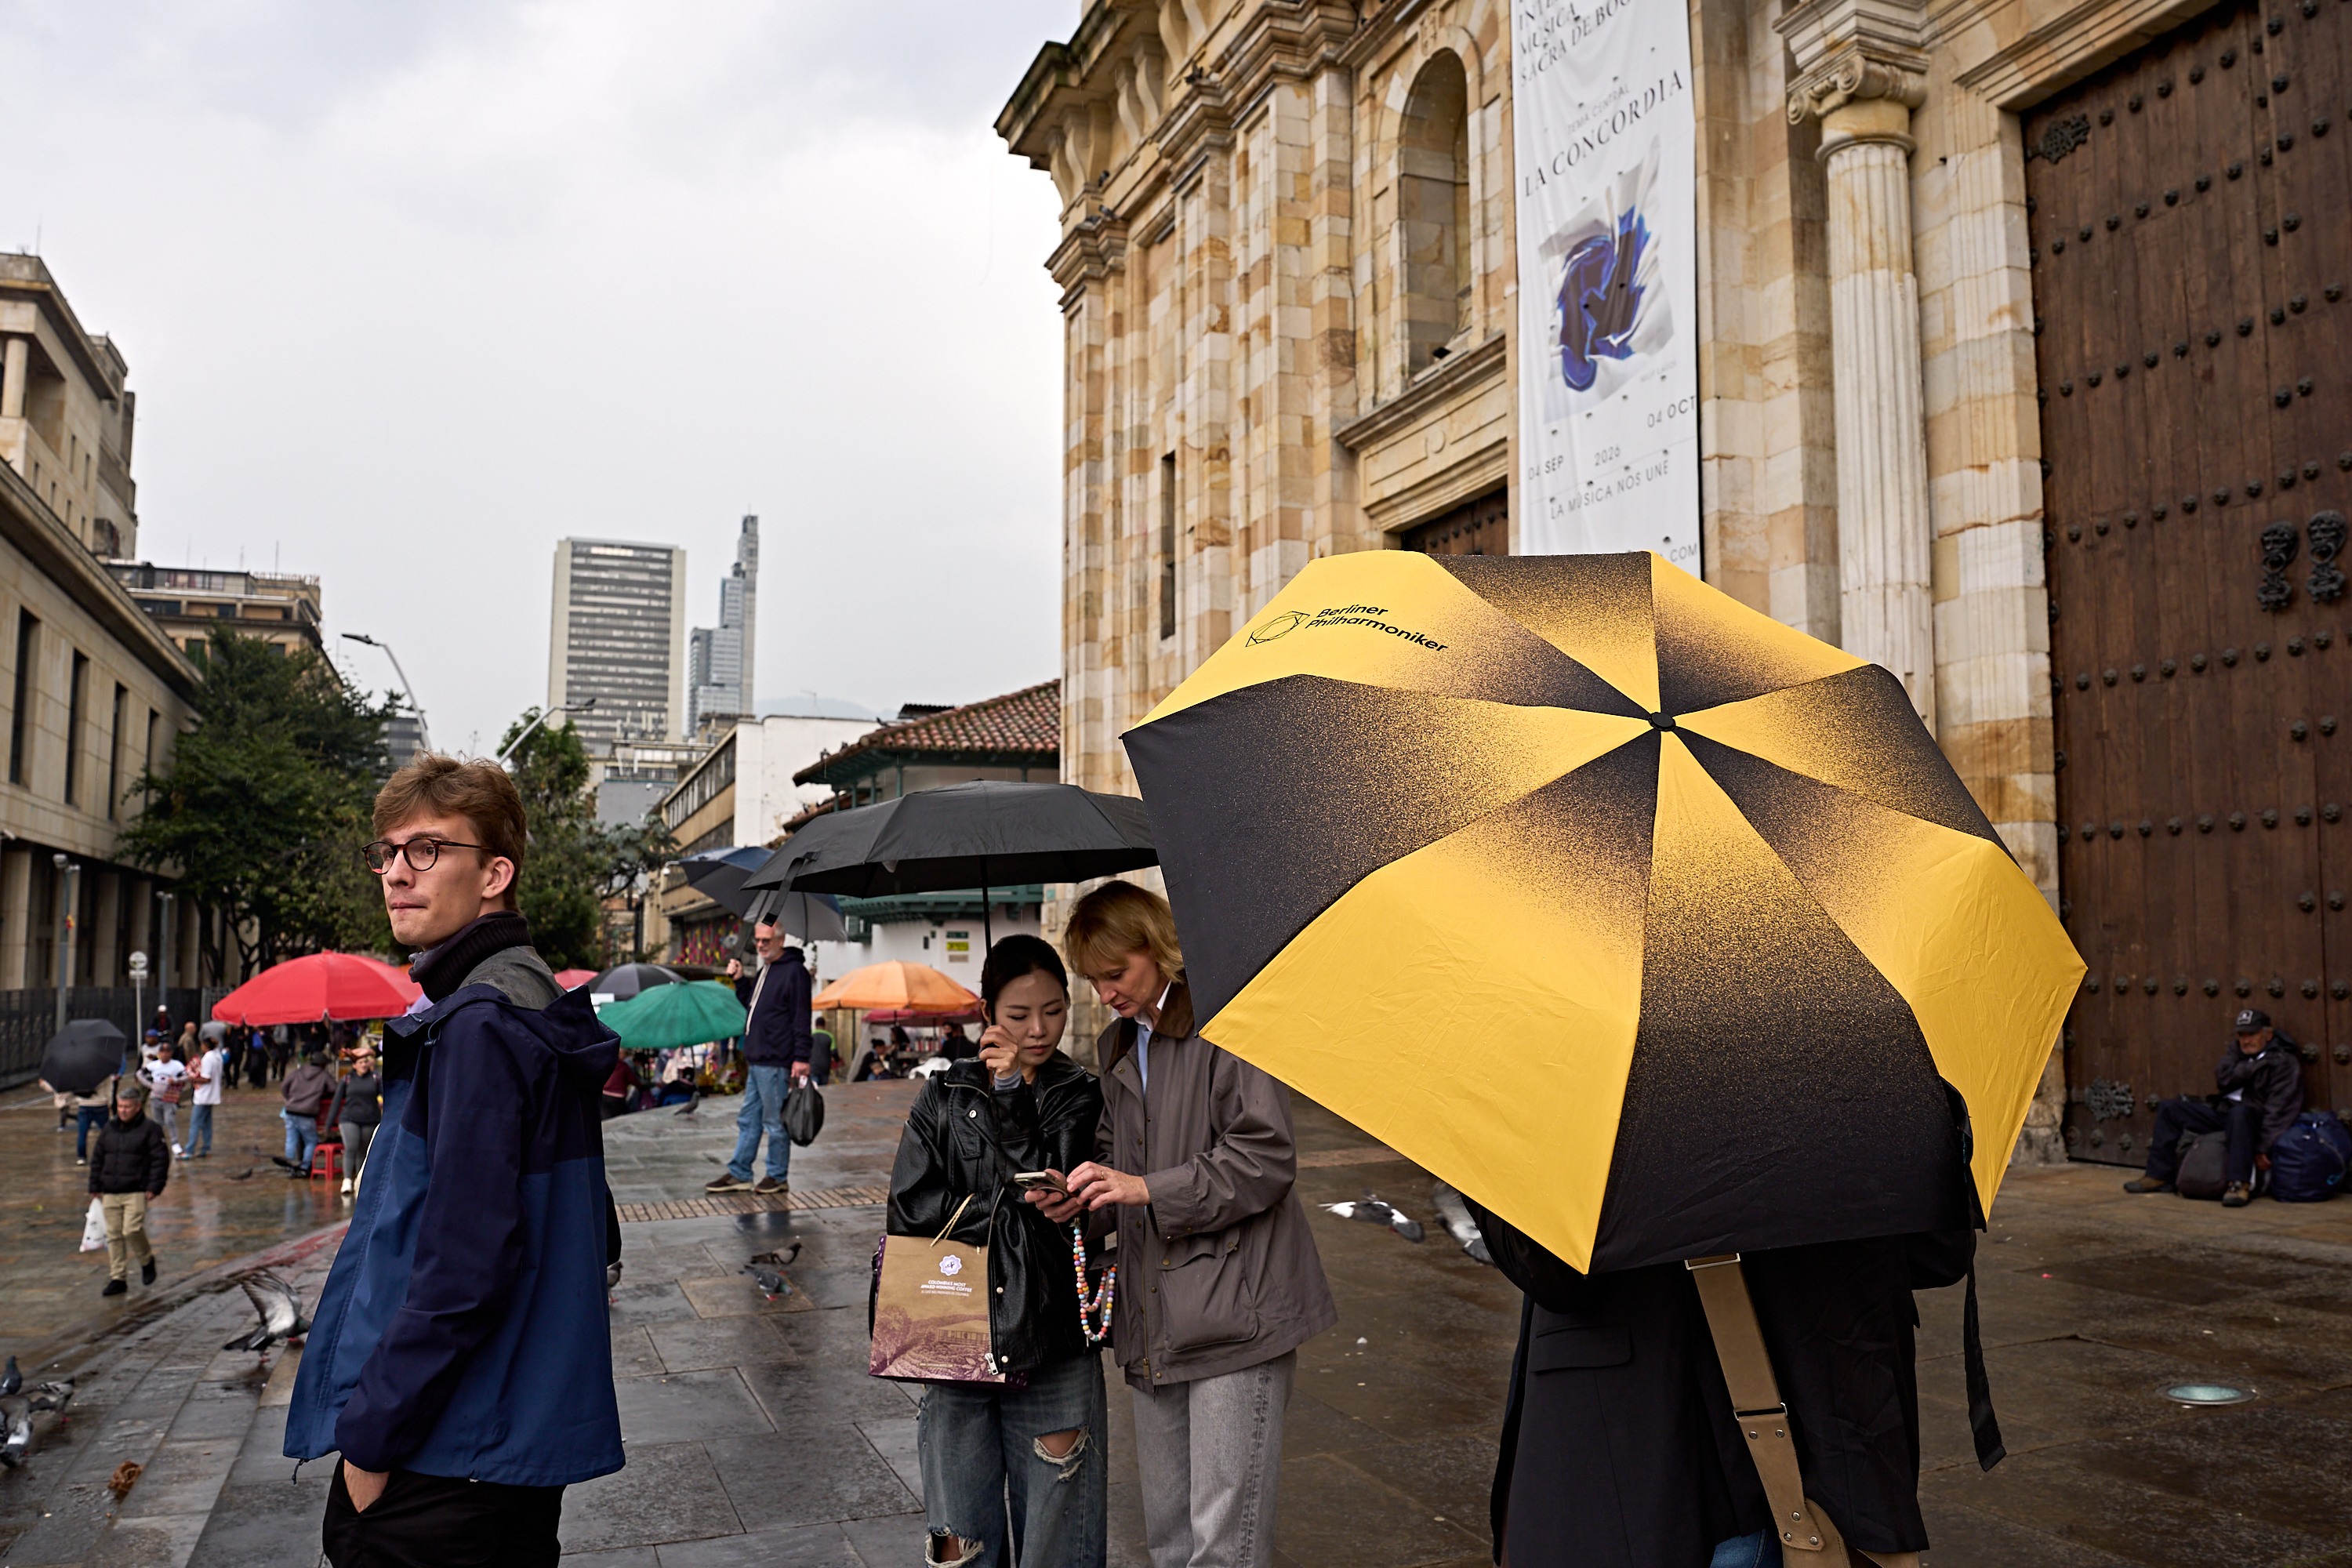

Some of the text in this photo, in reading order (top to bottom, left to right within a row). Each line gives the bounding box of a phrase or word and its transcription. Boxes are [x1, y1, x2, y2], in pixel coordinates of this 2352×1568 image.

[1521, 39, 1566, 87] SACRA
[1571, 14, 1592, 46] DE
[1525, 69, 1683, 197] LA CONCORDIA
[1647, 395, 1696, 428] 04 OCT
[1528, 455, 1565, 481] 04 SEP
[1594, 445, 1621, 466] 2026
[1550, 504, 1565, 520] LA
[1617, 472, 1642, 493] NOS
[1646, 459, 1670, 481] UNE
[1316, 604, 1388, 618] Berliner
[1305, 615, 1448, 652] Philharmoniker
